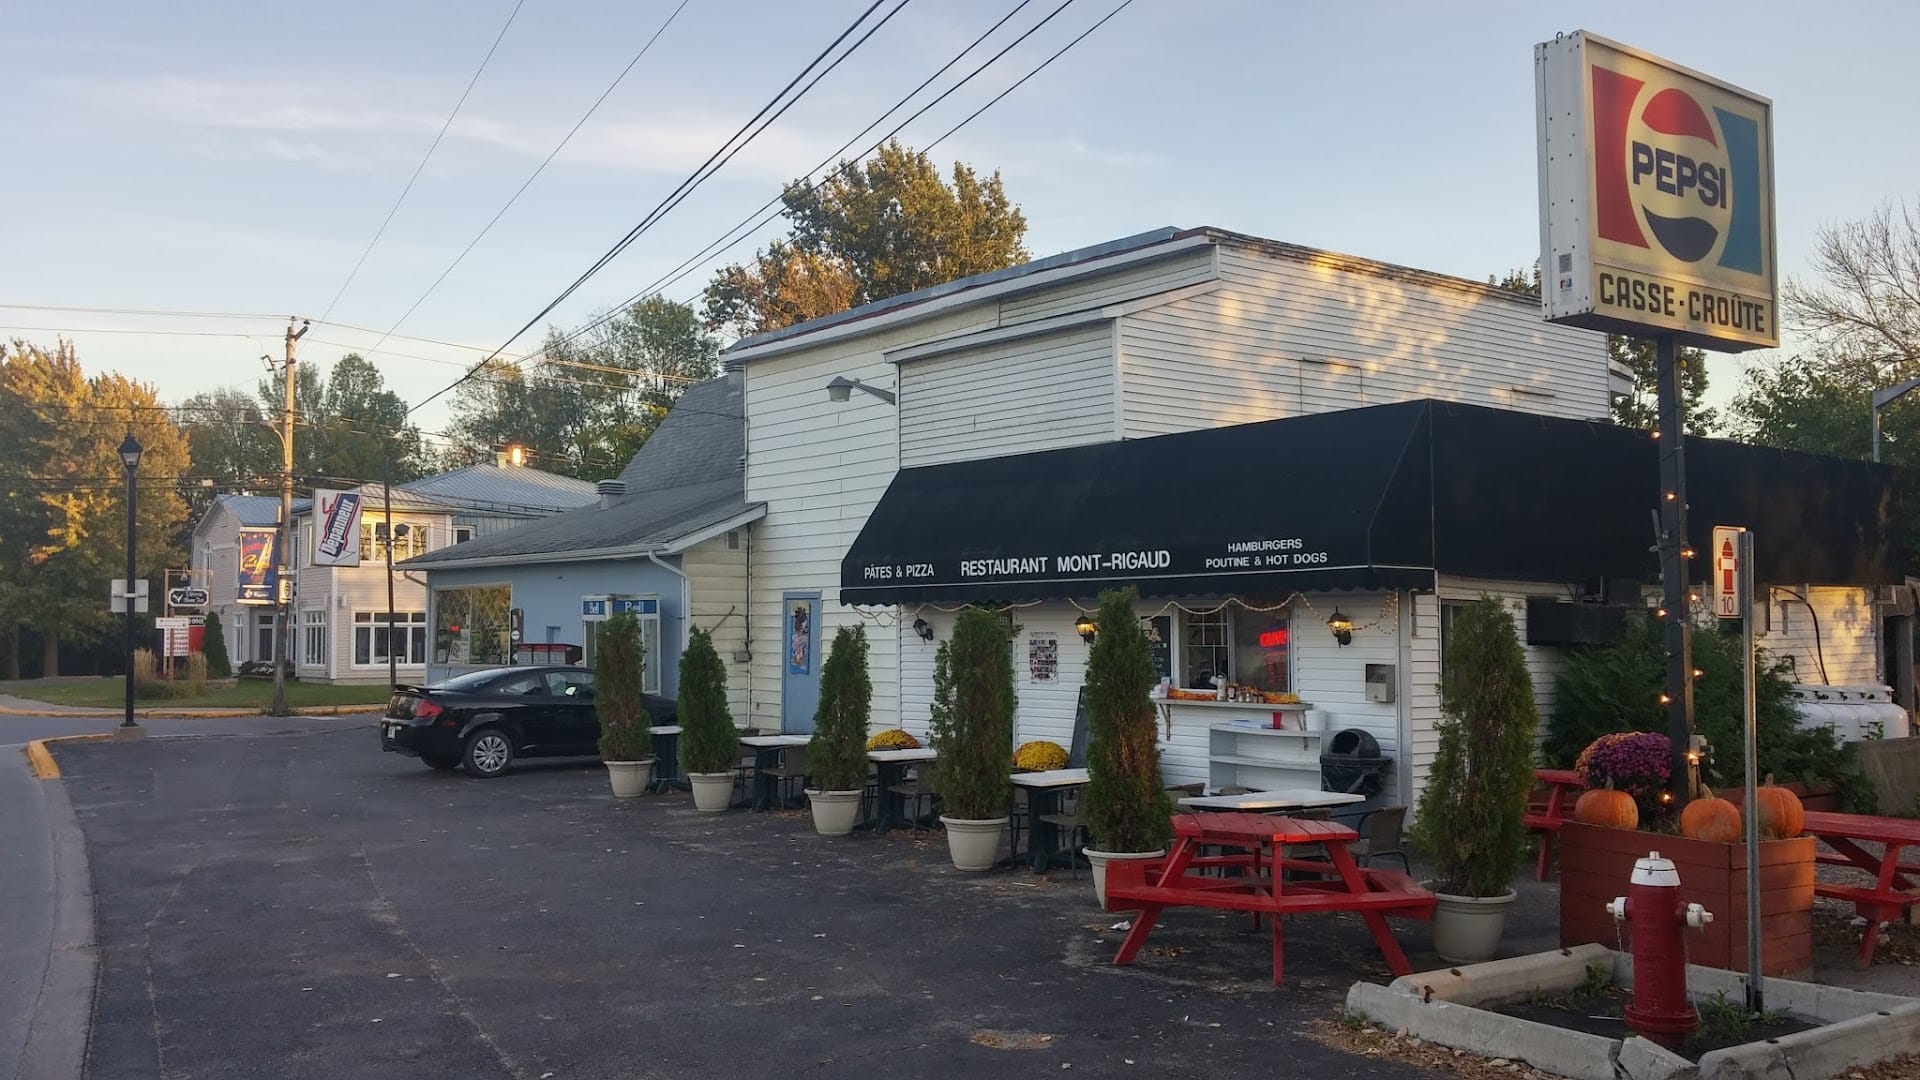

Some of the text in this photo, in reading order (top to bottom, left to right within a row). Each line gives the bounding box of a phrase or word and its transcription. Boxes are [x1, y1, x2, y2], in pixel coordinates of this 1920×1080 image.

[1632, 140, 1727, 209] PEPSI
[1227, 538, 1303, 553] HAMBURGERS
[961, 550, 1171, 577] RESTAURANT MONT-RIGAUD
[1205, 552, 1328, 569] POUTINE & HOT DOGS
[864, 563, 935, 579] PÂTES & PIZZA
[1721, 595, 1734, 613] 10
